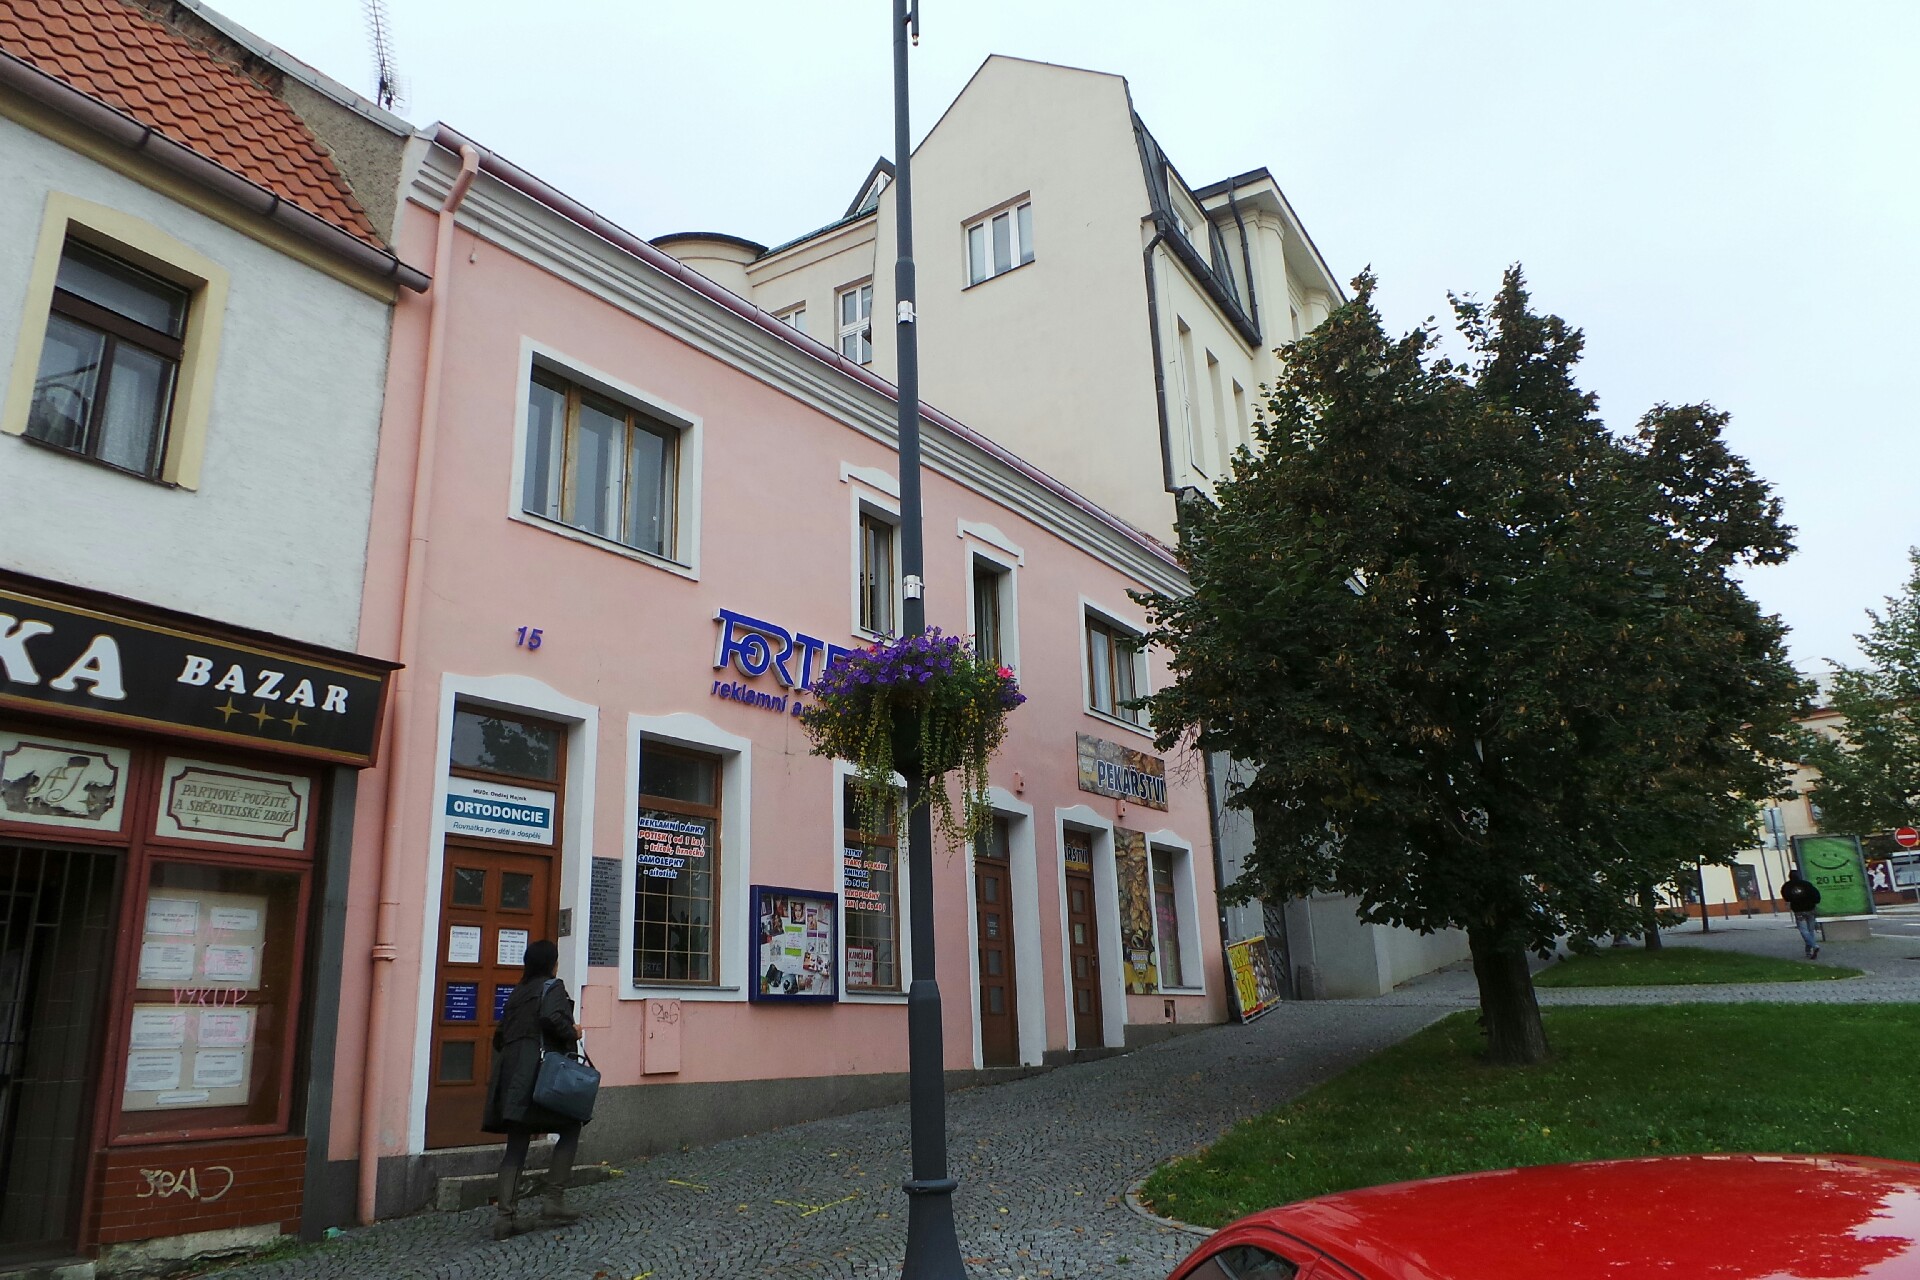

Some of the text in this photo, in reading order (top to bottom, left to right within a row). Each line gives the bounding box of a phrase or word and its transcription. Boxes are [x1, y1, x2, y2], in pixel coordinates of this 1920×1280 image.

[517, 626, 544, 650] 15
[177, 655, 348, 714] BAZAR
[711, 680, 788, 713] reklamní
[1097, 759, 1166, 804] PEKAŘSTVÍ
[174, 799, 296, 823] A SBĚRATELSKÉ ZBOŽÍ
[453, 800, 544, 824] ORTODONCIE
[453, 821, 484, 832] Rovnátka
[639, 816, 706, 835] REKLAMNÍ DÁRKY
[638, 830, 668, 843] POTISK
[638, 853, 685, 868] SAMOLEPKY
[844, 868, 870, 878] AMINACE
[1816, 875, 1854, 885] 20 LET
